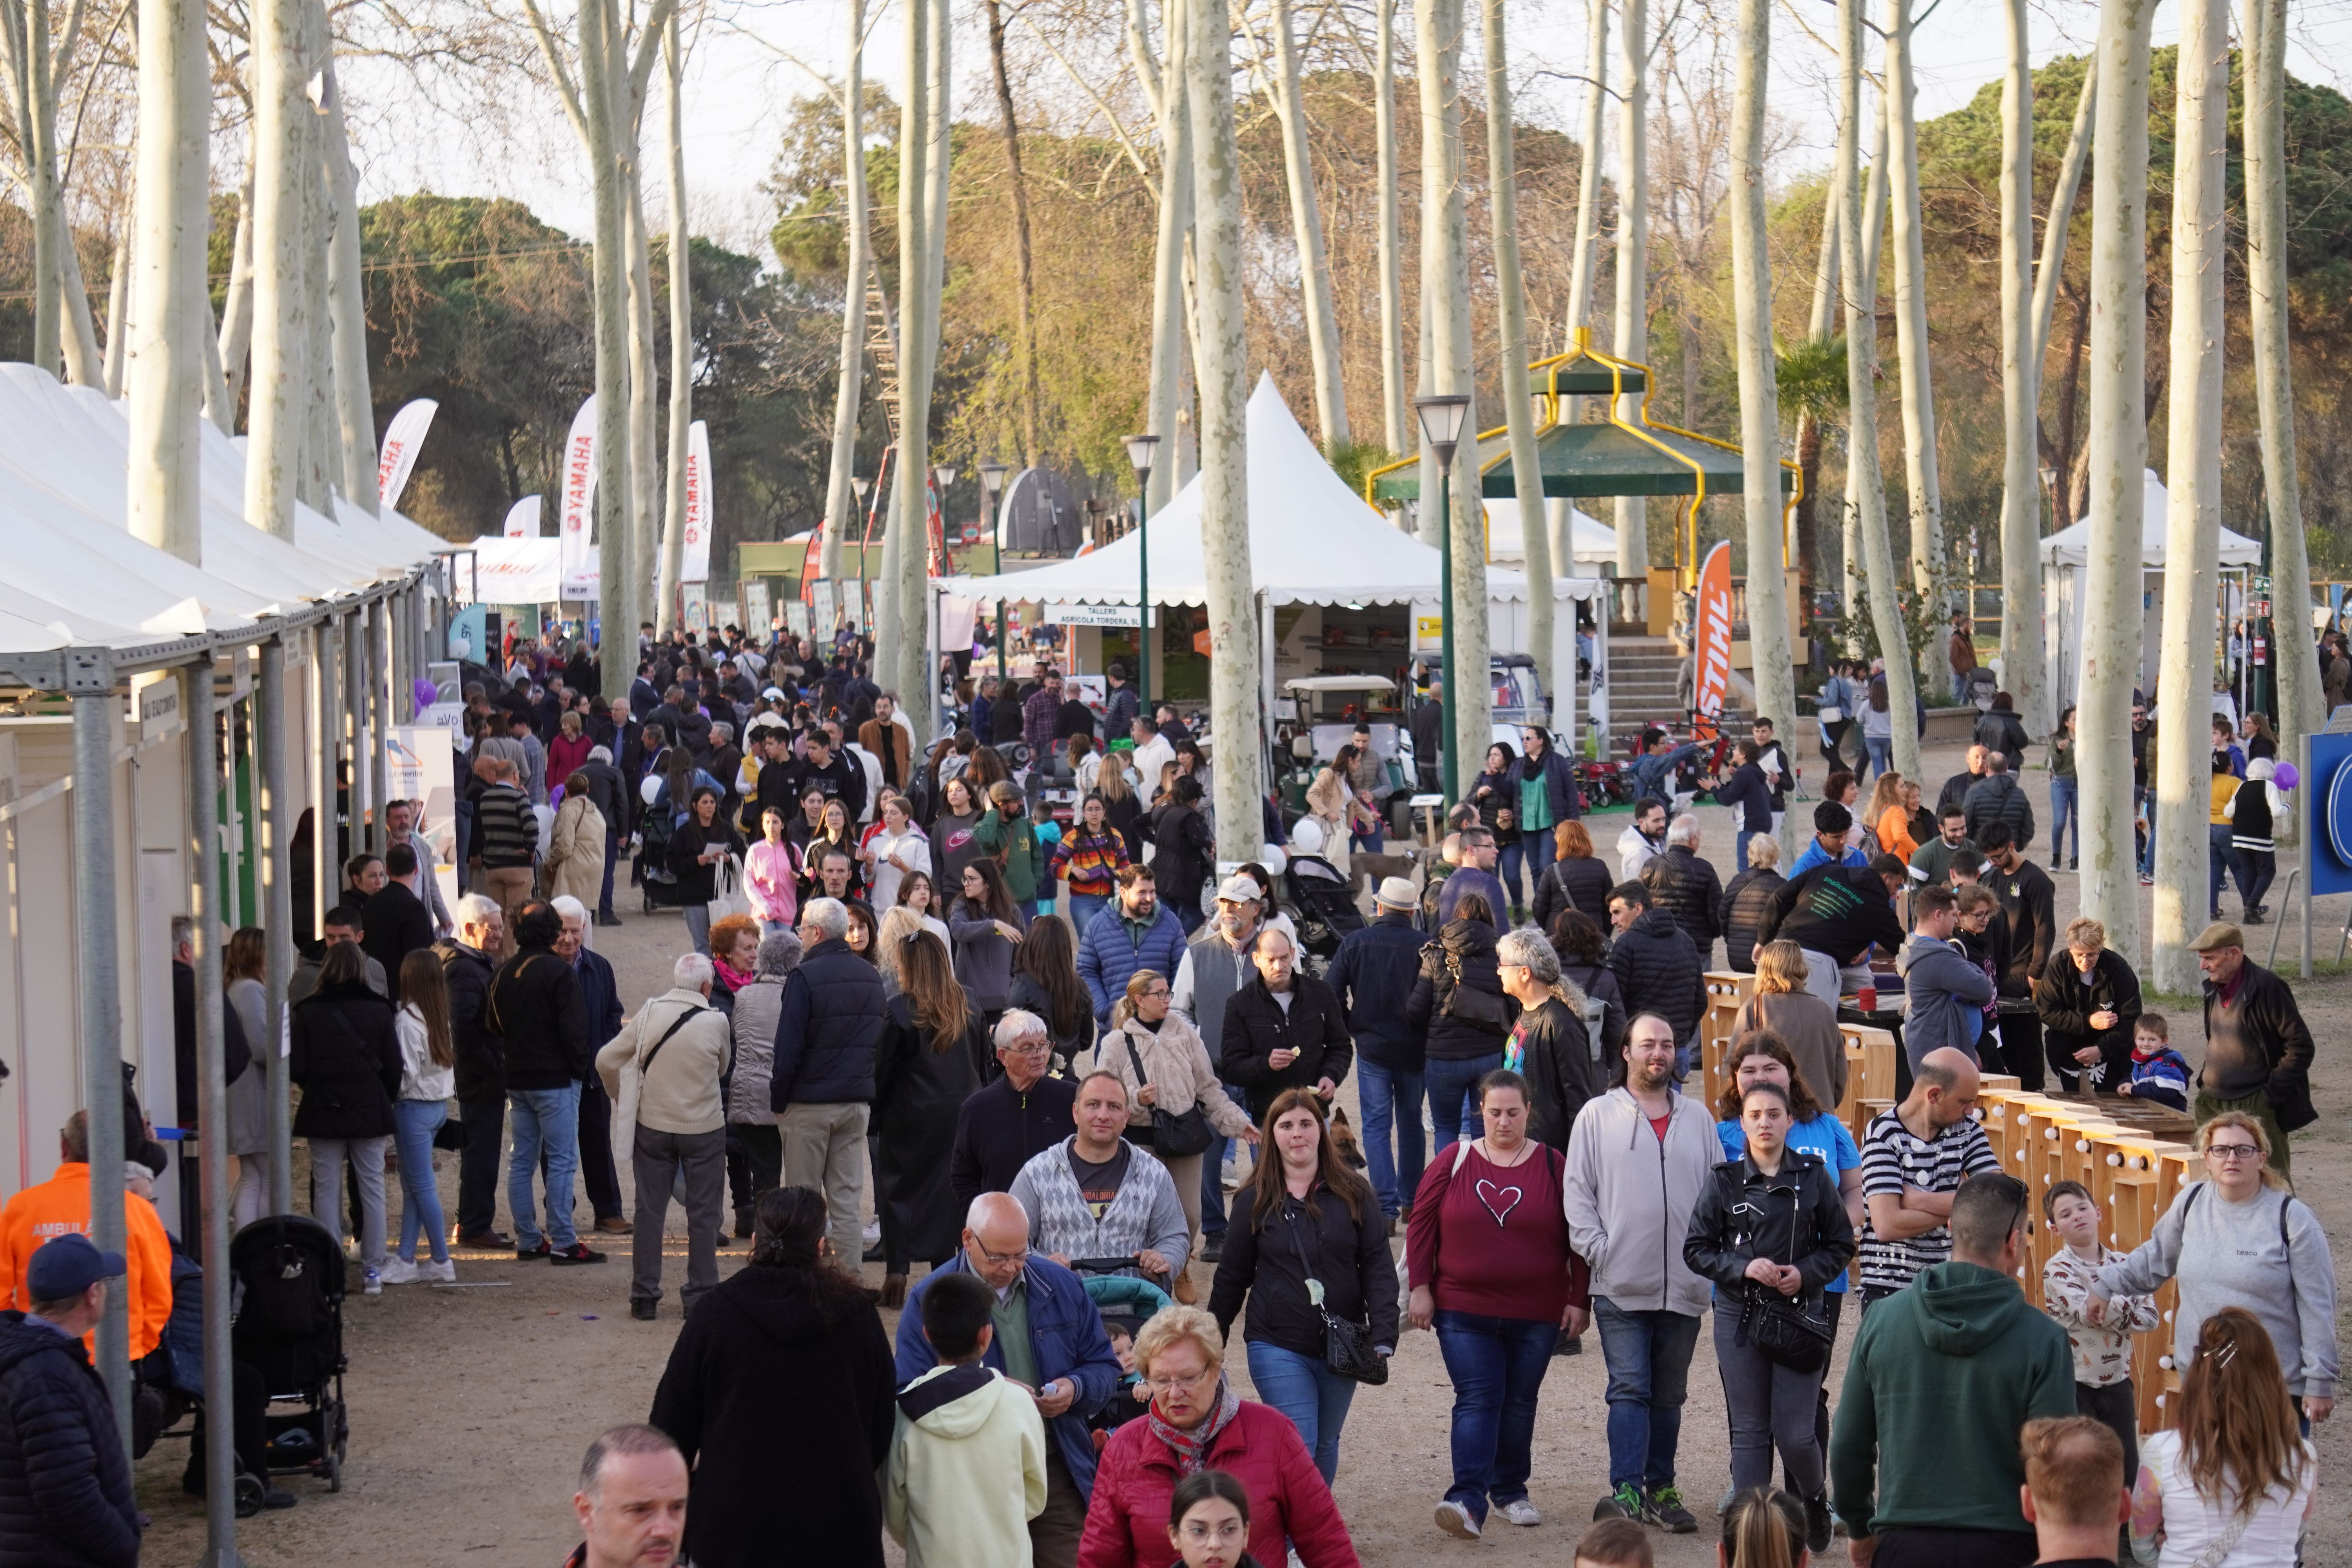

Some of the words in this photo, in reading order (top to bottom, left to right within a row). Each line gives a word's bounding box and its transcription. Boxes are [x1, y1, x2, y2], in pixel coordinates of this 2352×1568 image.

[568, 437, 592, 510] YAMAHA
[1061, 615, 1094, 624] AGRÍCOLA
[1097, 618, 1130, 627] TORDERA,
[1700, 591, 1730, 725] STIHL
[1823, 876, 1864, 905] snailcamper
